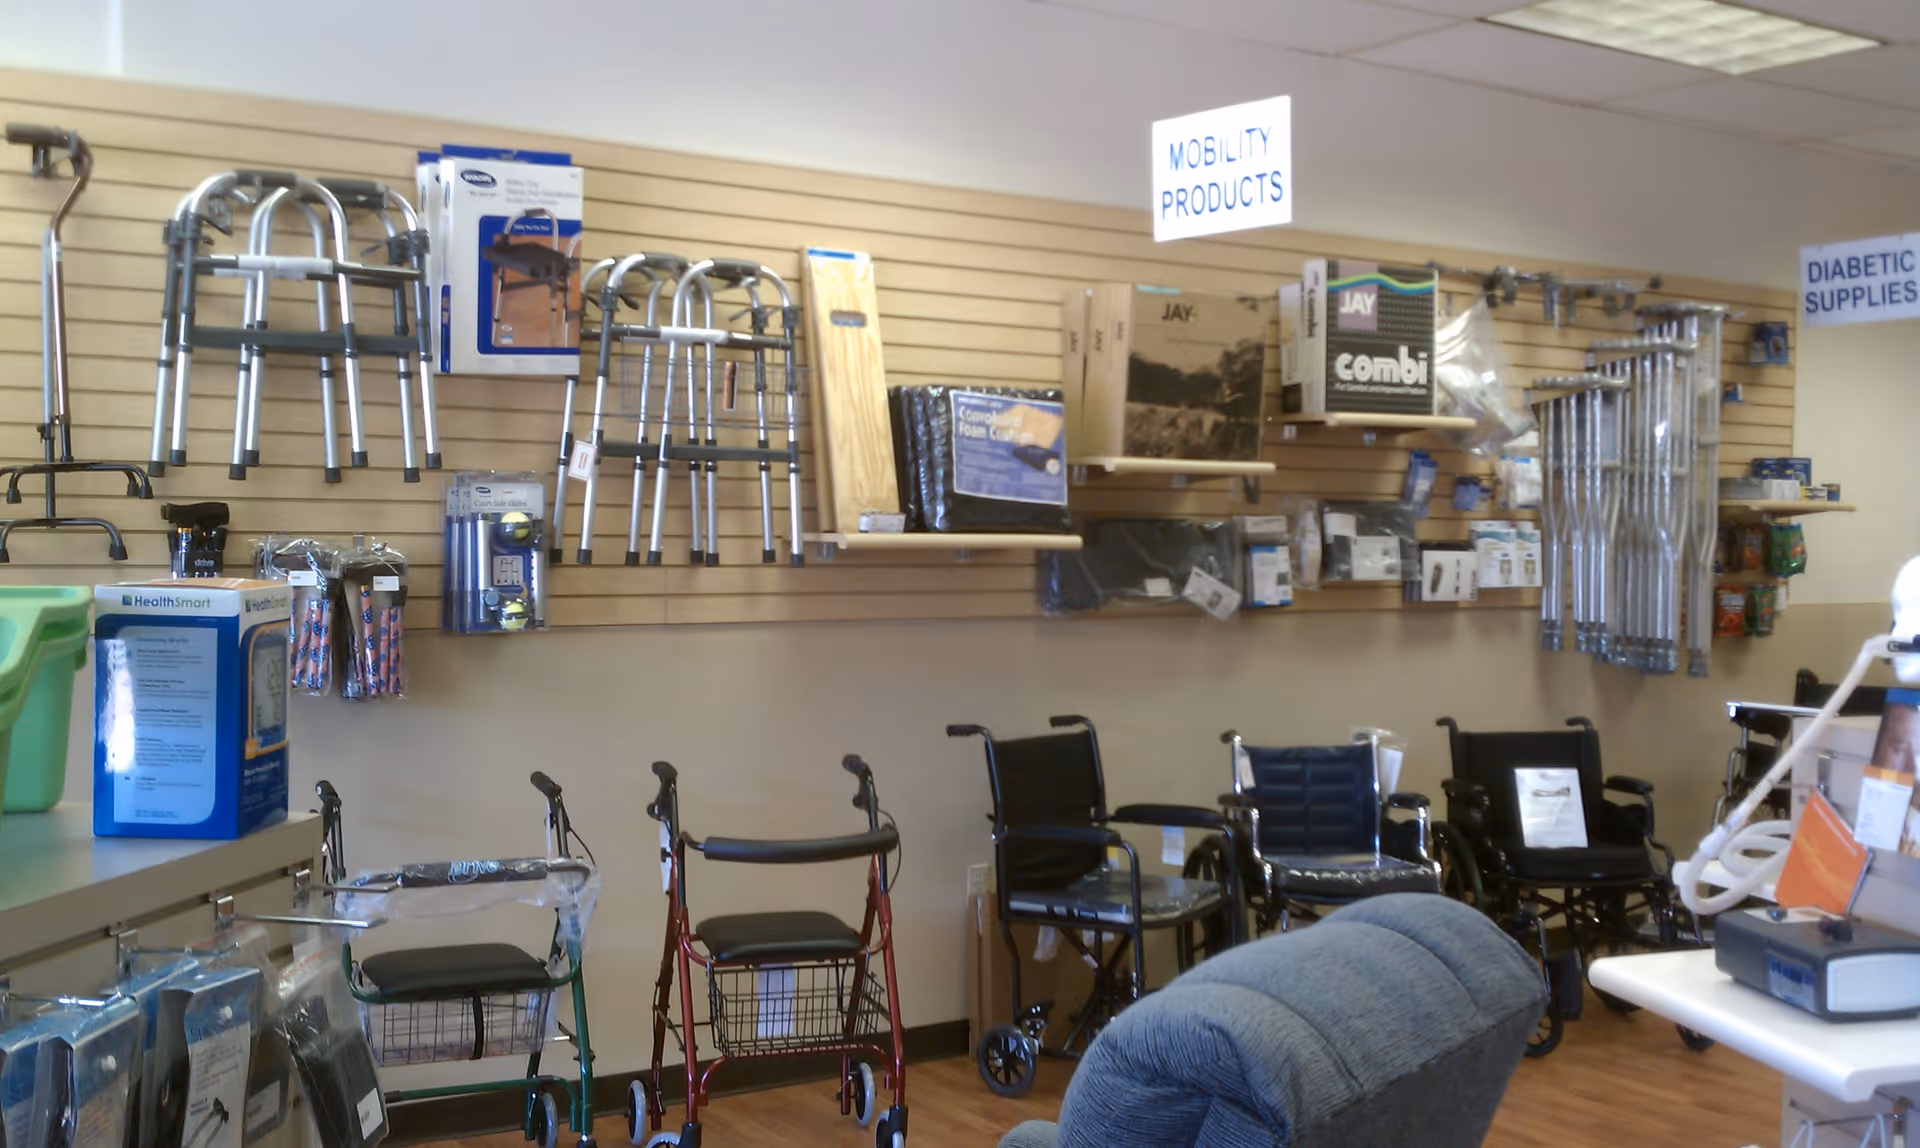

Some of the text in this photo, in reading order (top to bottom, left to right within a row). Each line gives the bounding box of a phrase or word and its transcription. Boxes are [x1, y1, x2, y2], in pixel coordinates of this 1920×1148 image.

[1169, 126, 1272, 172] MOBILITY
[1161, 169, 1284, 220] PRODUCTS
[1807, 249, 1915, 284] DIABETIC
[1161, 302, 1193, 322] JAY
[1339, 290, 1377, 316] JAY
[1805, 279, 1919, 314] SUPPLIES
[1334, 344, 1428, 385] combi
[194, 558, 215, 567] drive
[134, 595, 211, 609] HealthSmart
